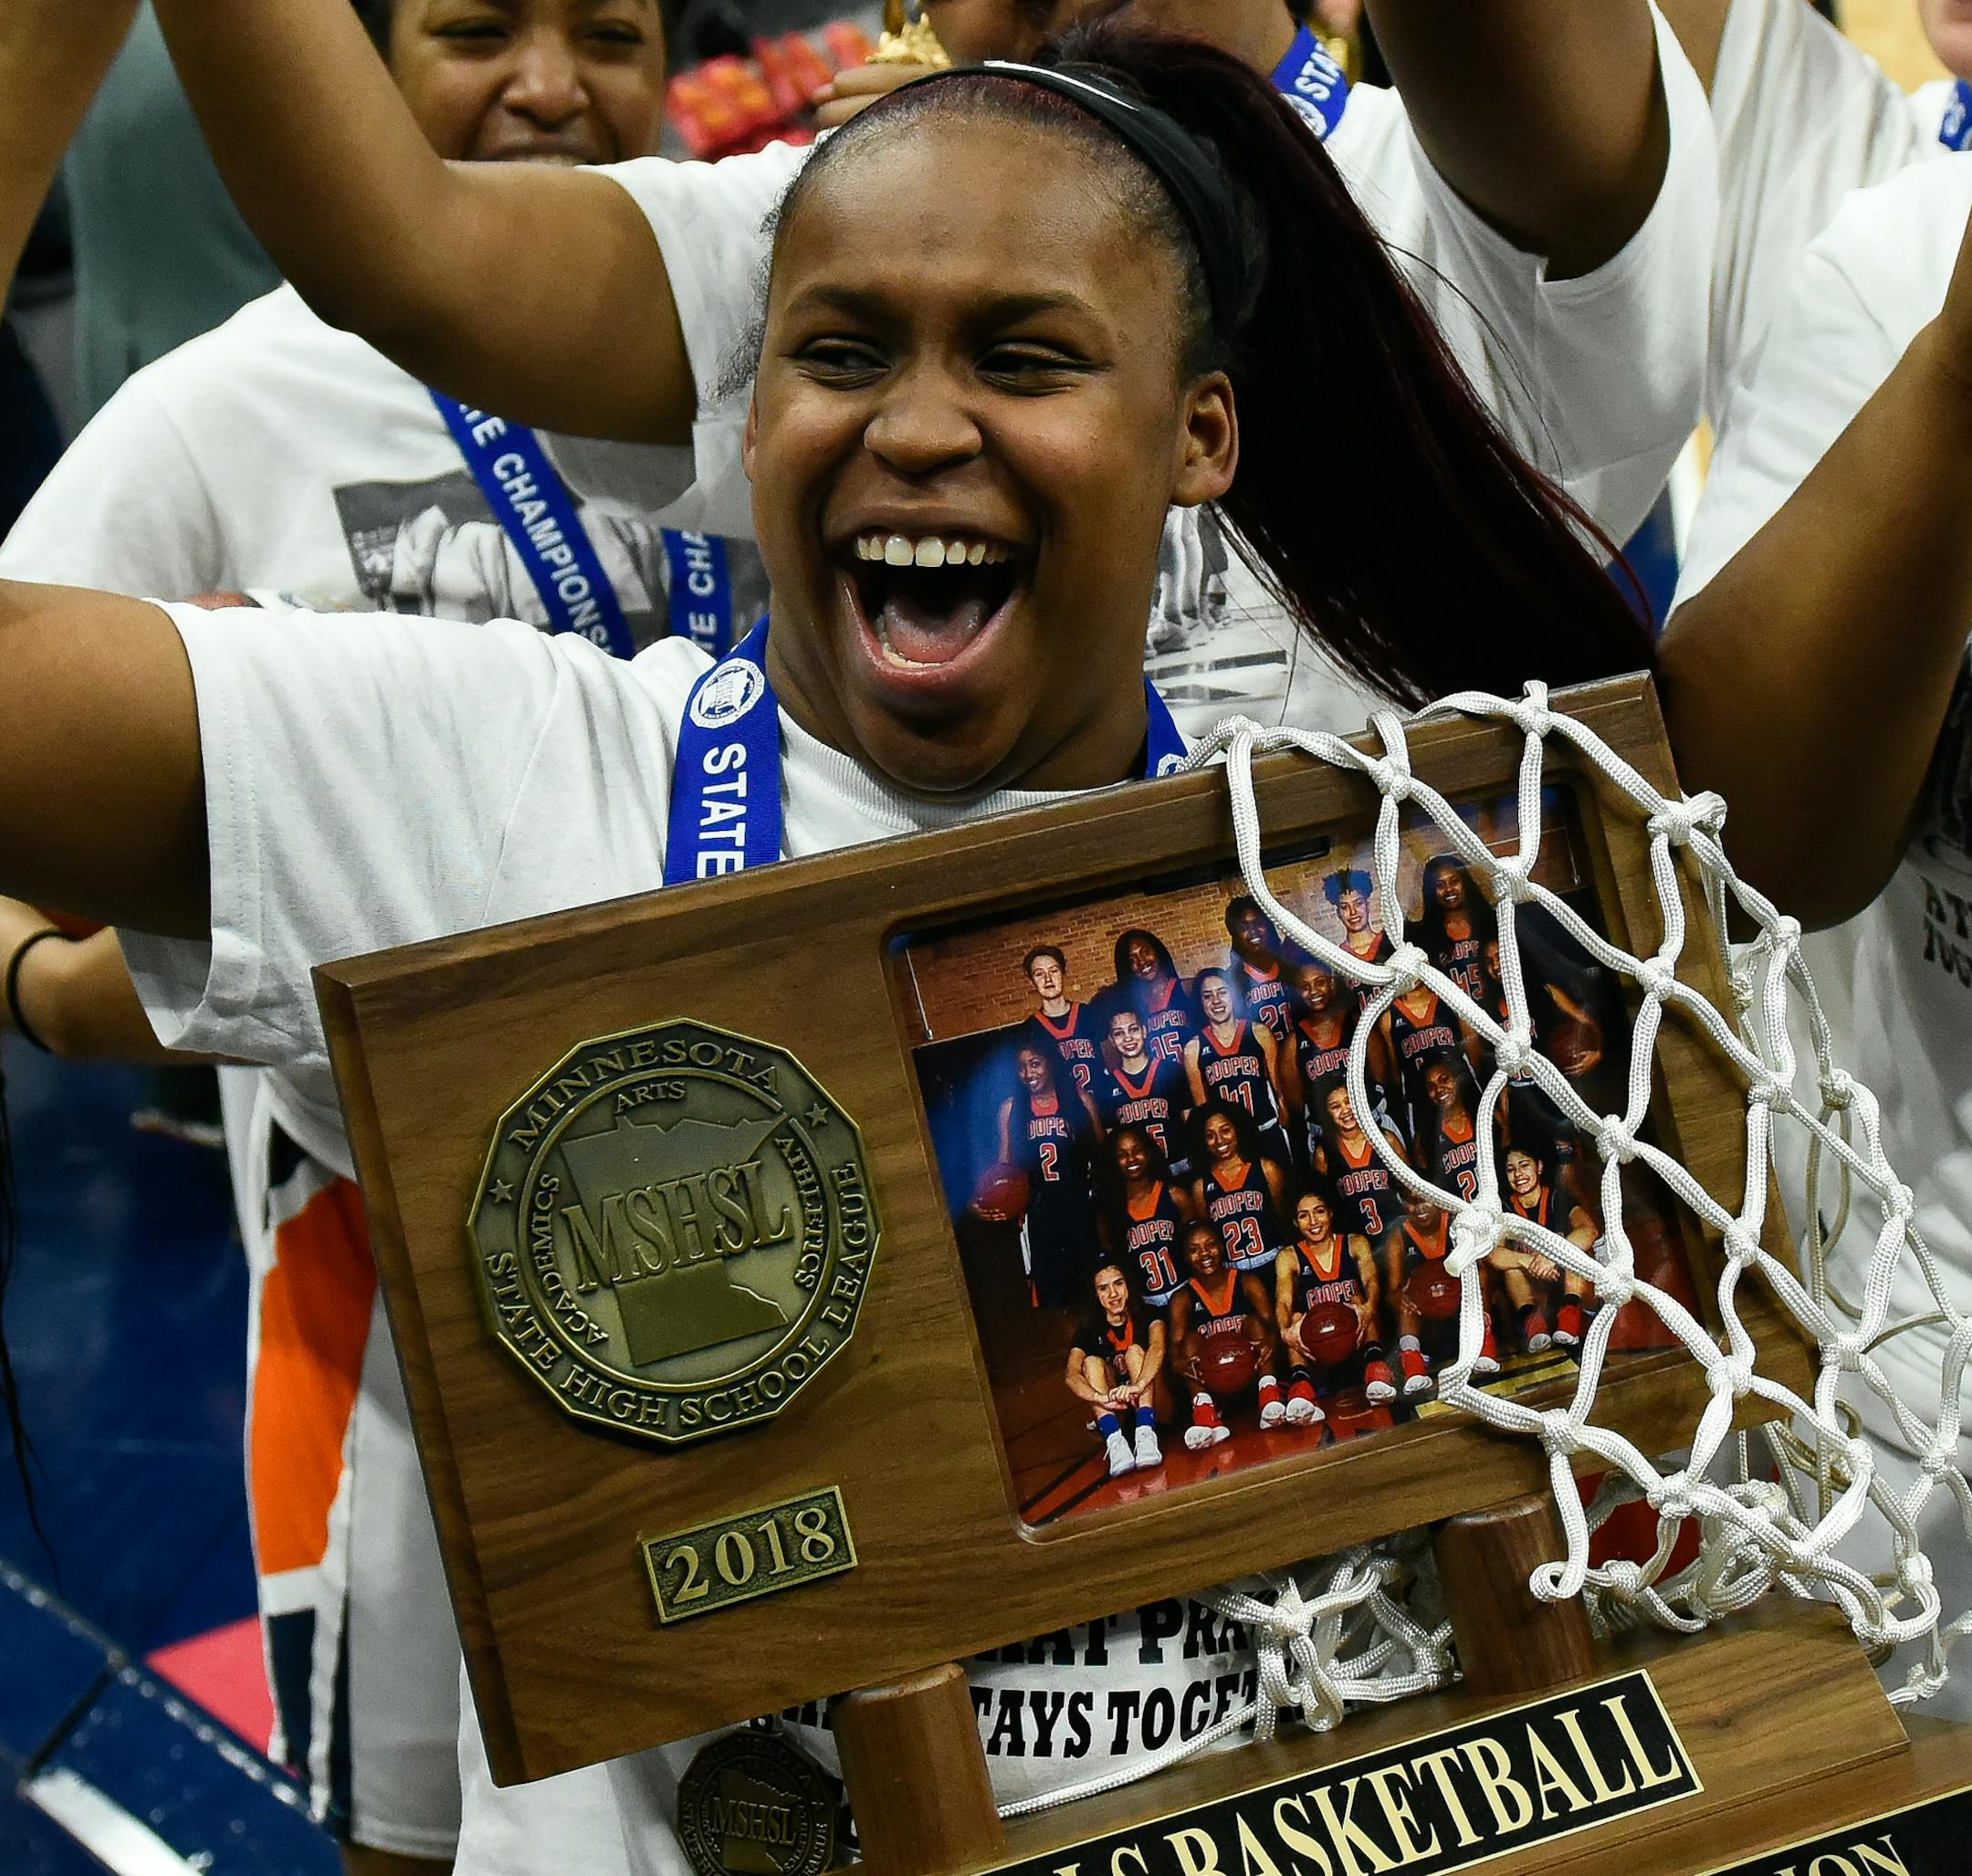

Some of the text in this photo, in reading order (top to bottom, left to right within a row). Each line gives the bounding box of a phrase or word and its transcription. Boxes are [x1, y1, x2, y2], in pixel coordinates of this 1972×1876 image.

[491, 452, 614, 654] CHAMPIONS
[696, 742, 748, 880] STATE
[1258, 1001, 1295, 1042] 21
[1400, 1026, 1456, 1059] COOPER
[1149, 1031, 1185, 1064] 15
[1204, 1055, 1260, 1086] COOPER
[508, 1038, 779, 1152] MINNESOTA
[614, 1080, 687, 1114] ARTS
[1039, 1142, 1060, 1182] 2
[561, 1159, 794, 1294] MSHSL
[774, 1135, 825, 1289] ATHLETICS
[1209, 1190, 1264, 1223] COOPER
[1358, 1198, 1384, 1236] 3
[532, 1172, 610, 1346] ACADEMICS
[1222, 1216, 1265, 1262] 23
[1138, 1246, 1178, 1293] 31
[486, 1162, 869, 1428] STATE HIGH SCHOOL LEAGUE
[665, 1507, 835, 1604] 2018
[1163, 1694, 1684, 1876] BASKETBALL
